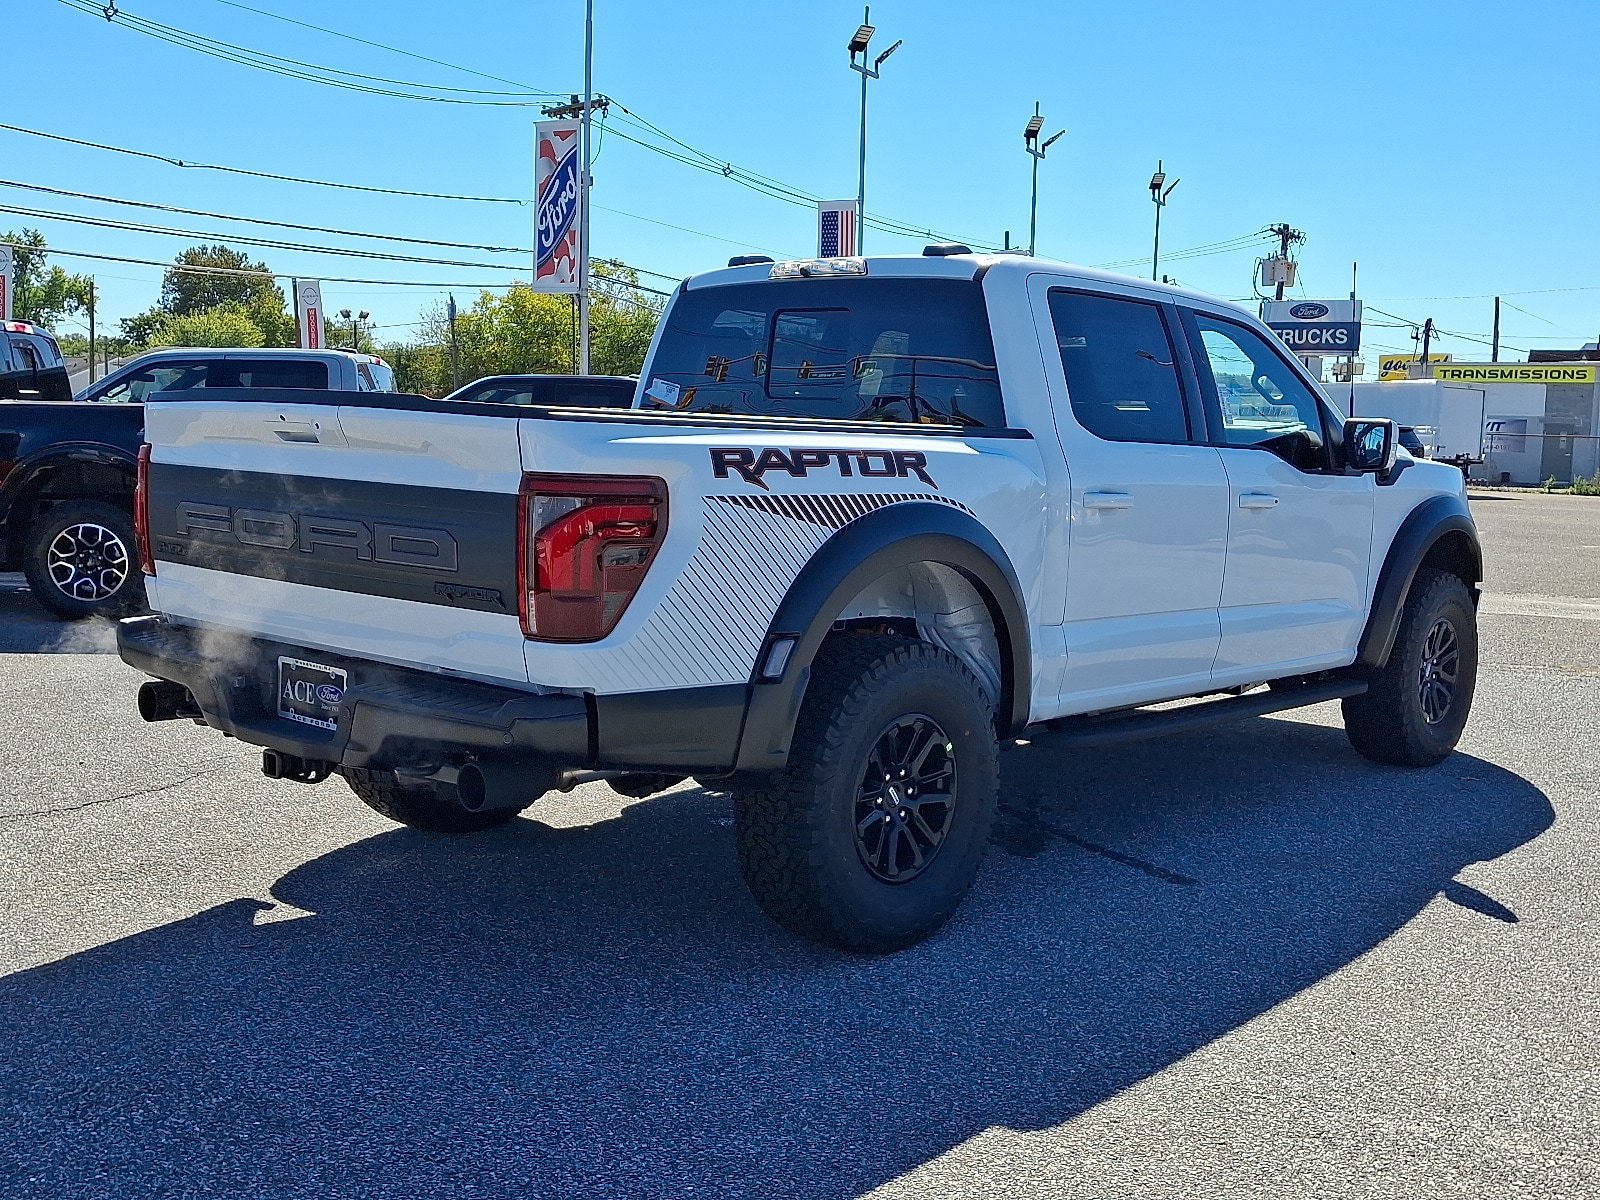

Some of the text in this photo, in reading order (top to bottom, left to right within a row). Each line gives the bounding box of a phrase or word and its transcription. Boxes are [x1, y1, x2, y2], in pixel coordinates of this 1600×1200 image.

[538, 165, 577, 247] Ford
[1439, 368, 1588, 380] TRANSMISSIONS
[709, 447, 939, 491] RAPTOR
[175, 500, 459, 573] FORD
[434, 581, 507, 611] RAPTOR
[282, 678, 339, 705] ACE Ford
[310, 719, 330, 728] FORD
